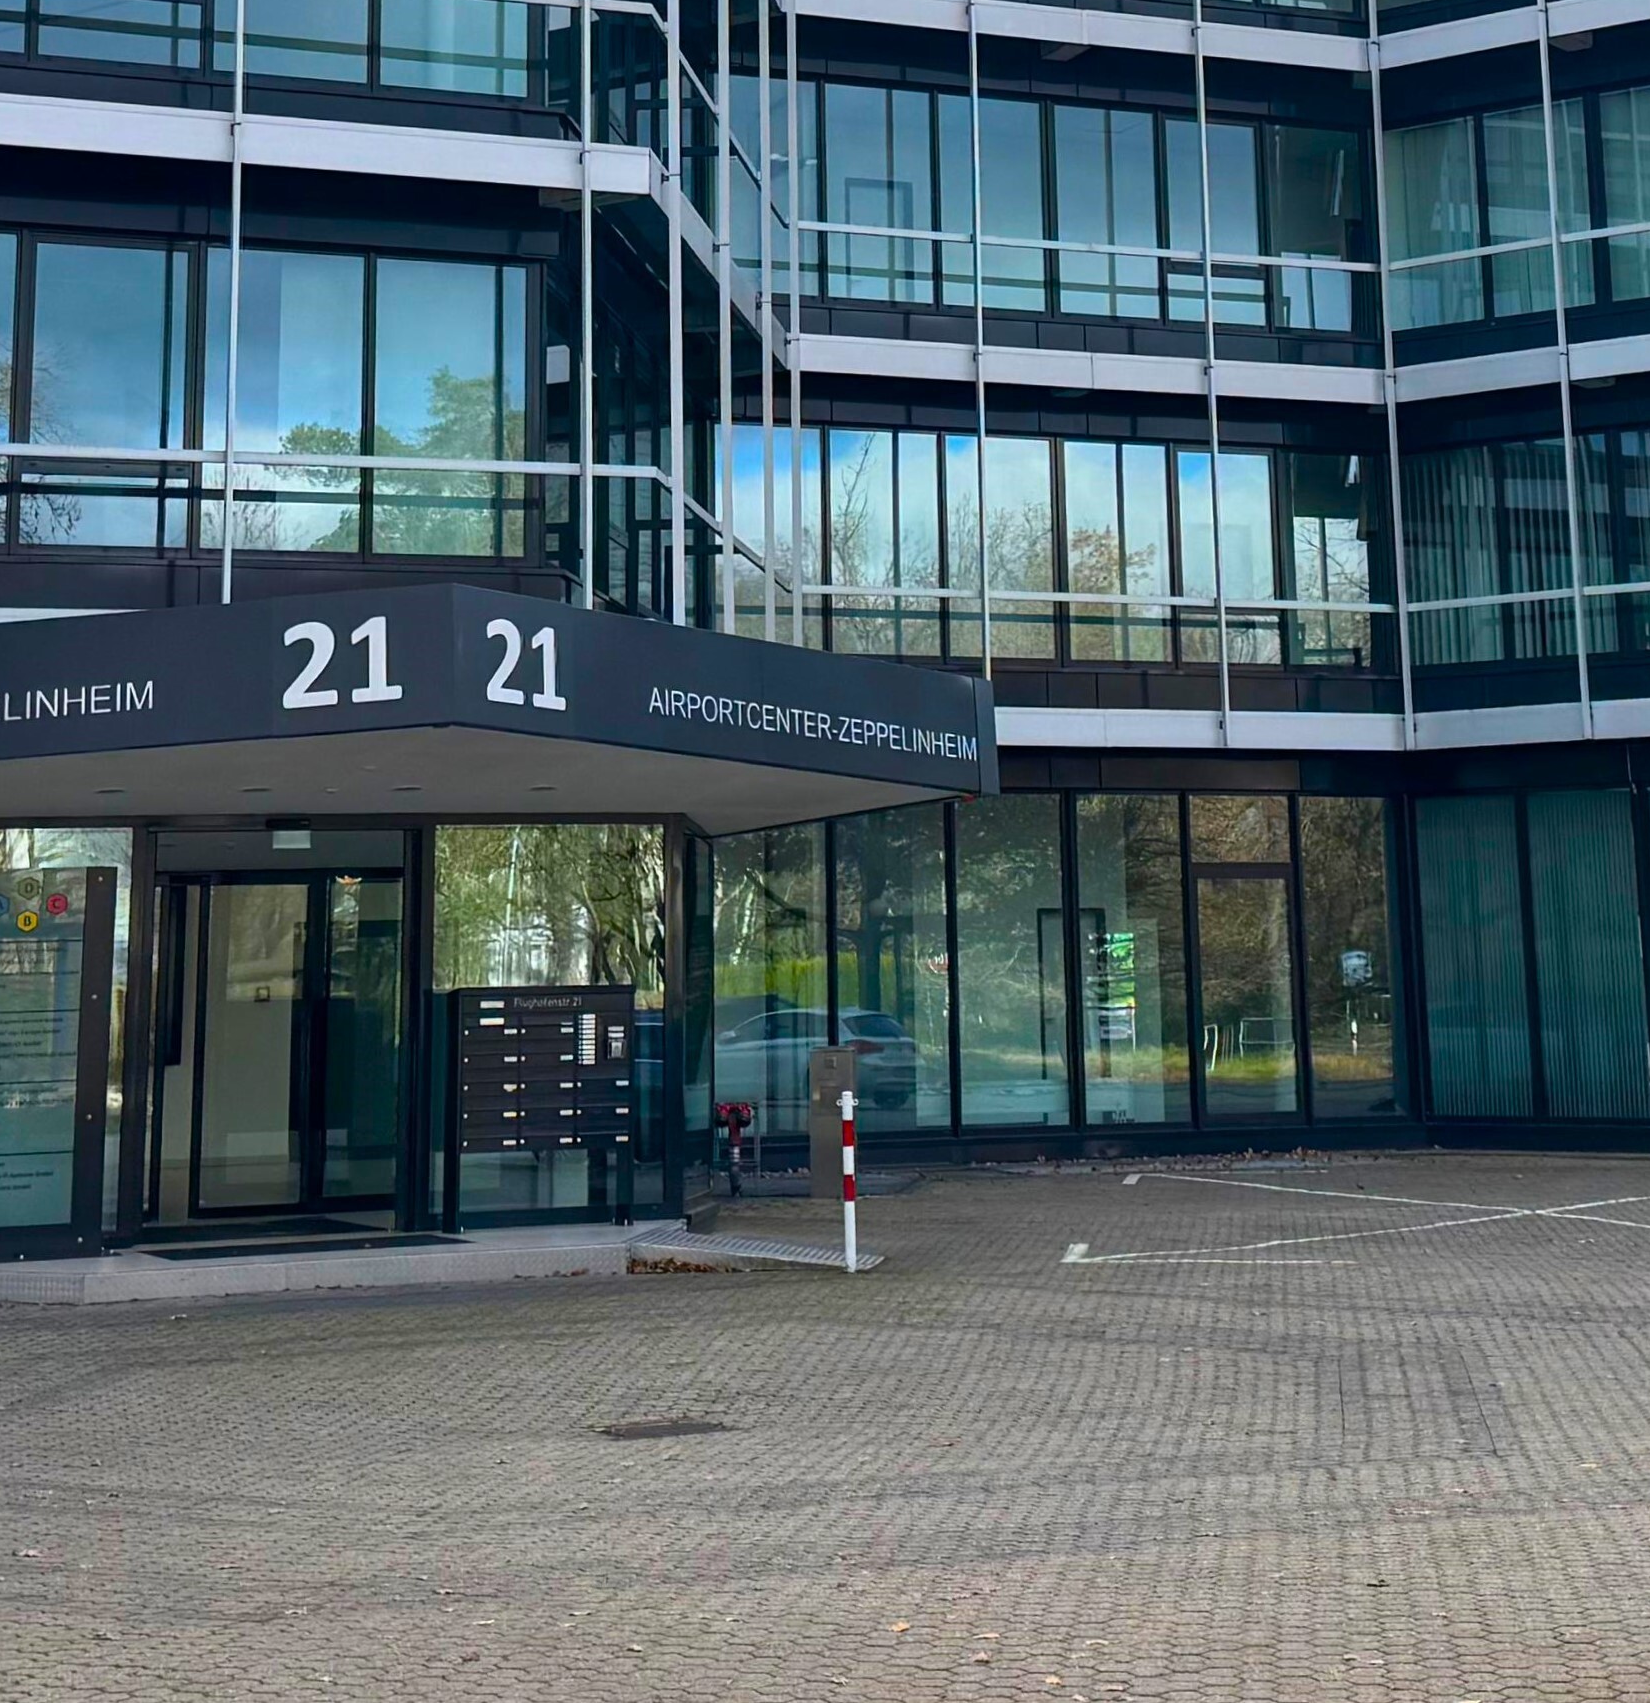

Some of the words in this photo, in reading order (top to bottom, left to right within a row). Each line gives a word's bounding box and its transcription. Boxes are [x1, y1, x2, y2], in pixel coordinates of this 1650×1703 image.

[282, 616, 403, 710] 21
[486, 618, 567, 711] 21
[649, 686, 978, 762] AIRPORTCENTER-ZEPPELINHEIM
[23, 915, 32, 927] B
